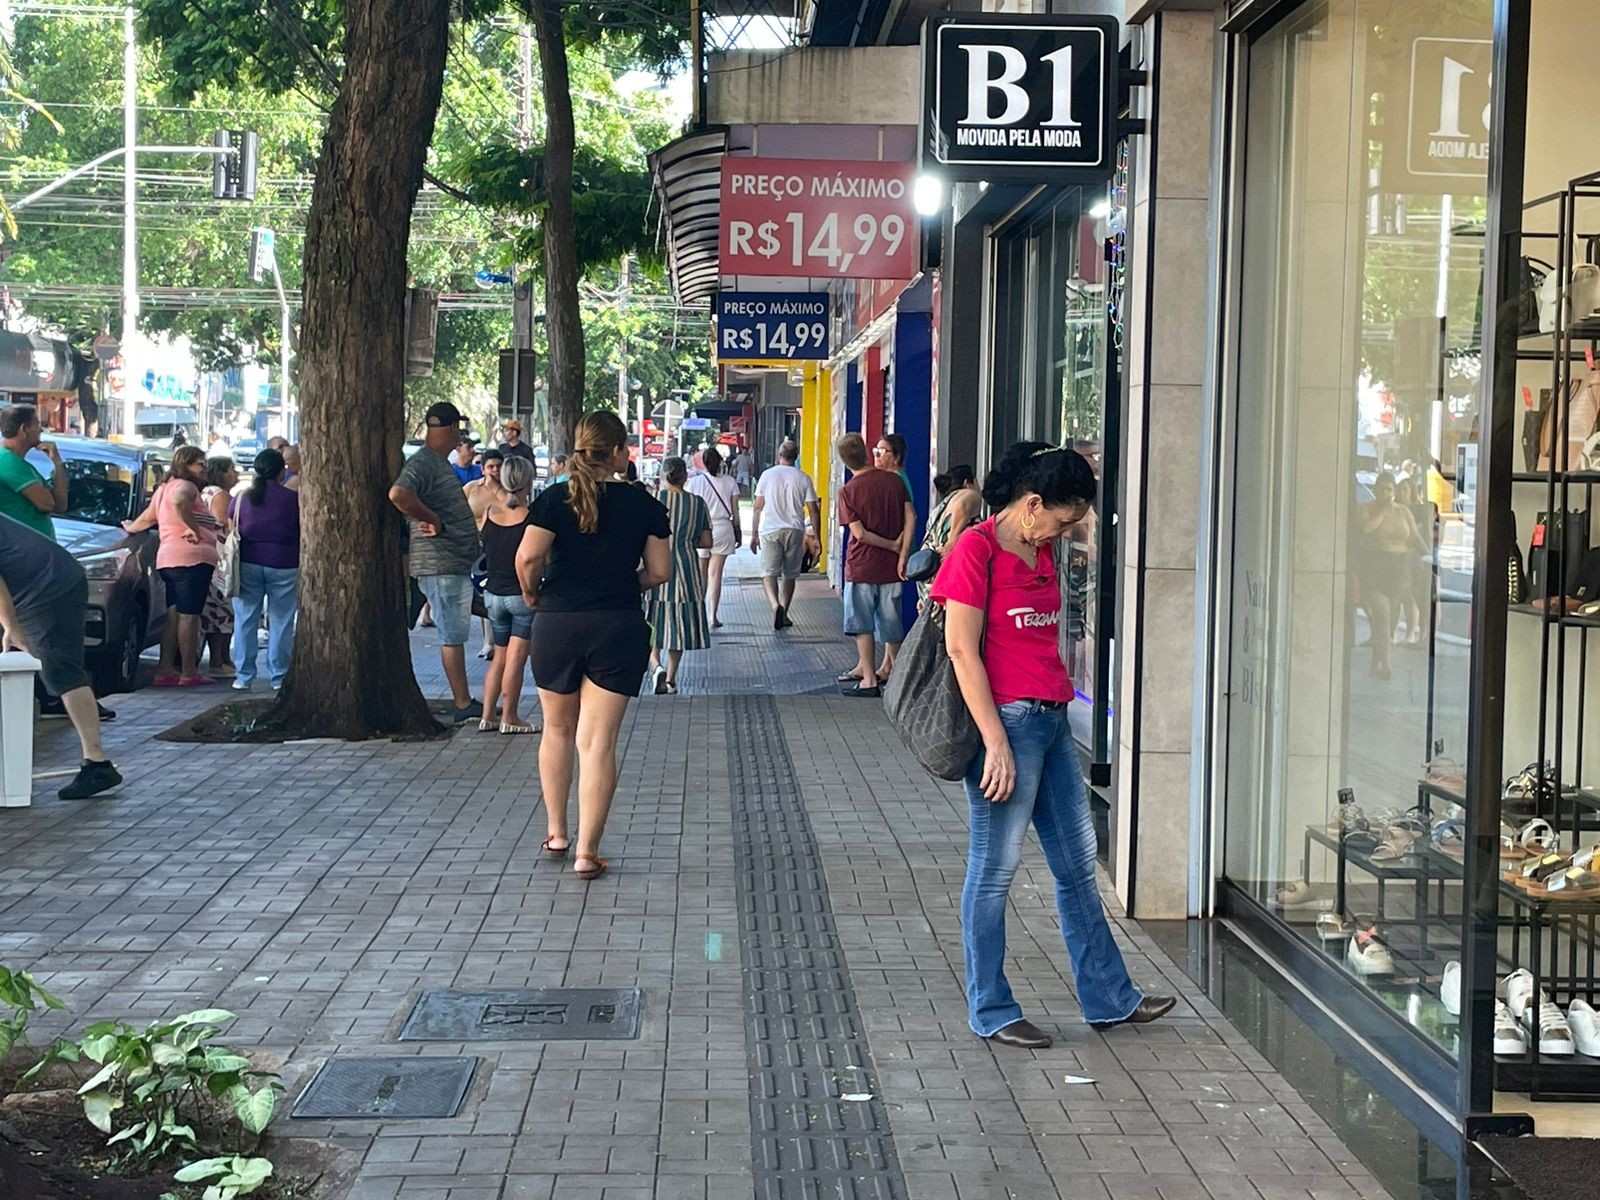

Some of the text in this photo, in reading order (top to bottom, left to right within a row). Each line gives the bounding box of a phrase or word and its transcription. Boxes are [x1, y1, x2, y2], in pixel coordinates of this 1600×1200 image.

[957, 44, 1082, 126] B1
[956, 128, 1082, 148] MOVIDA PELA MODA
[731, 171, 906, 202] PREÇO MÁXIMO
[729, 212, 906, 273] R$14,99
[723, 298, 825, 318] PREÇO MÁXIMO
[723, 322, 826, 358] R$14,99
